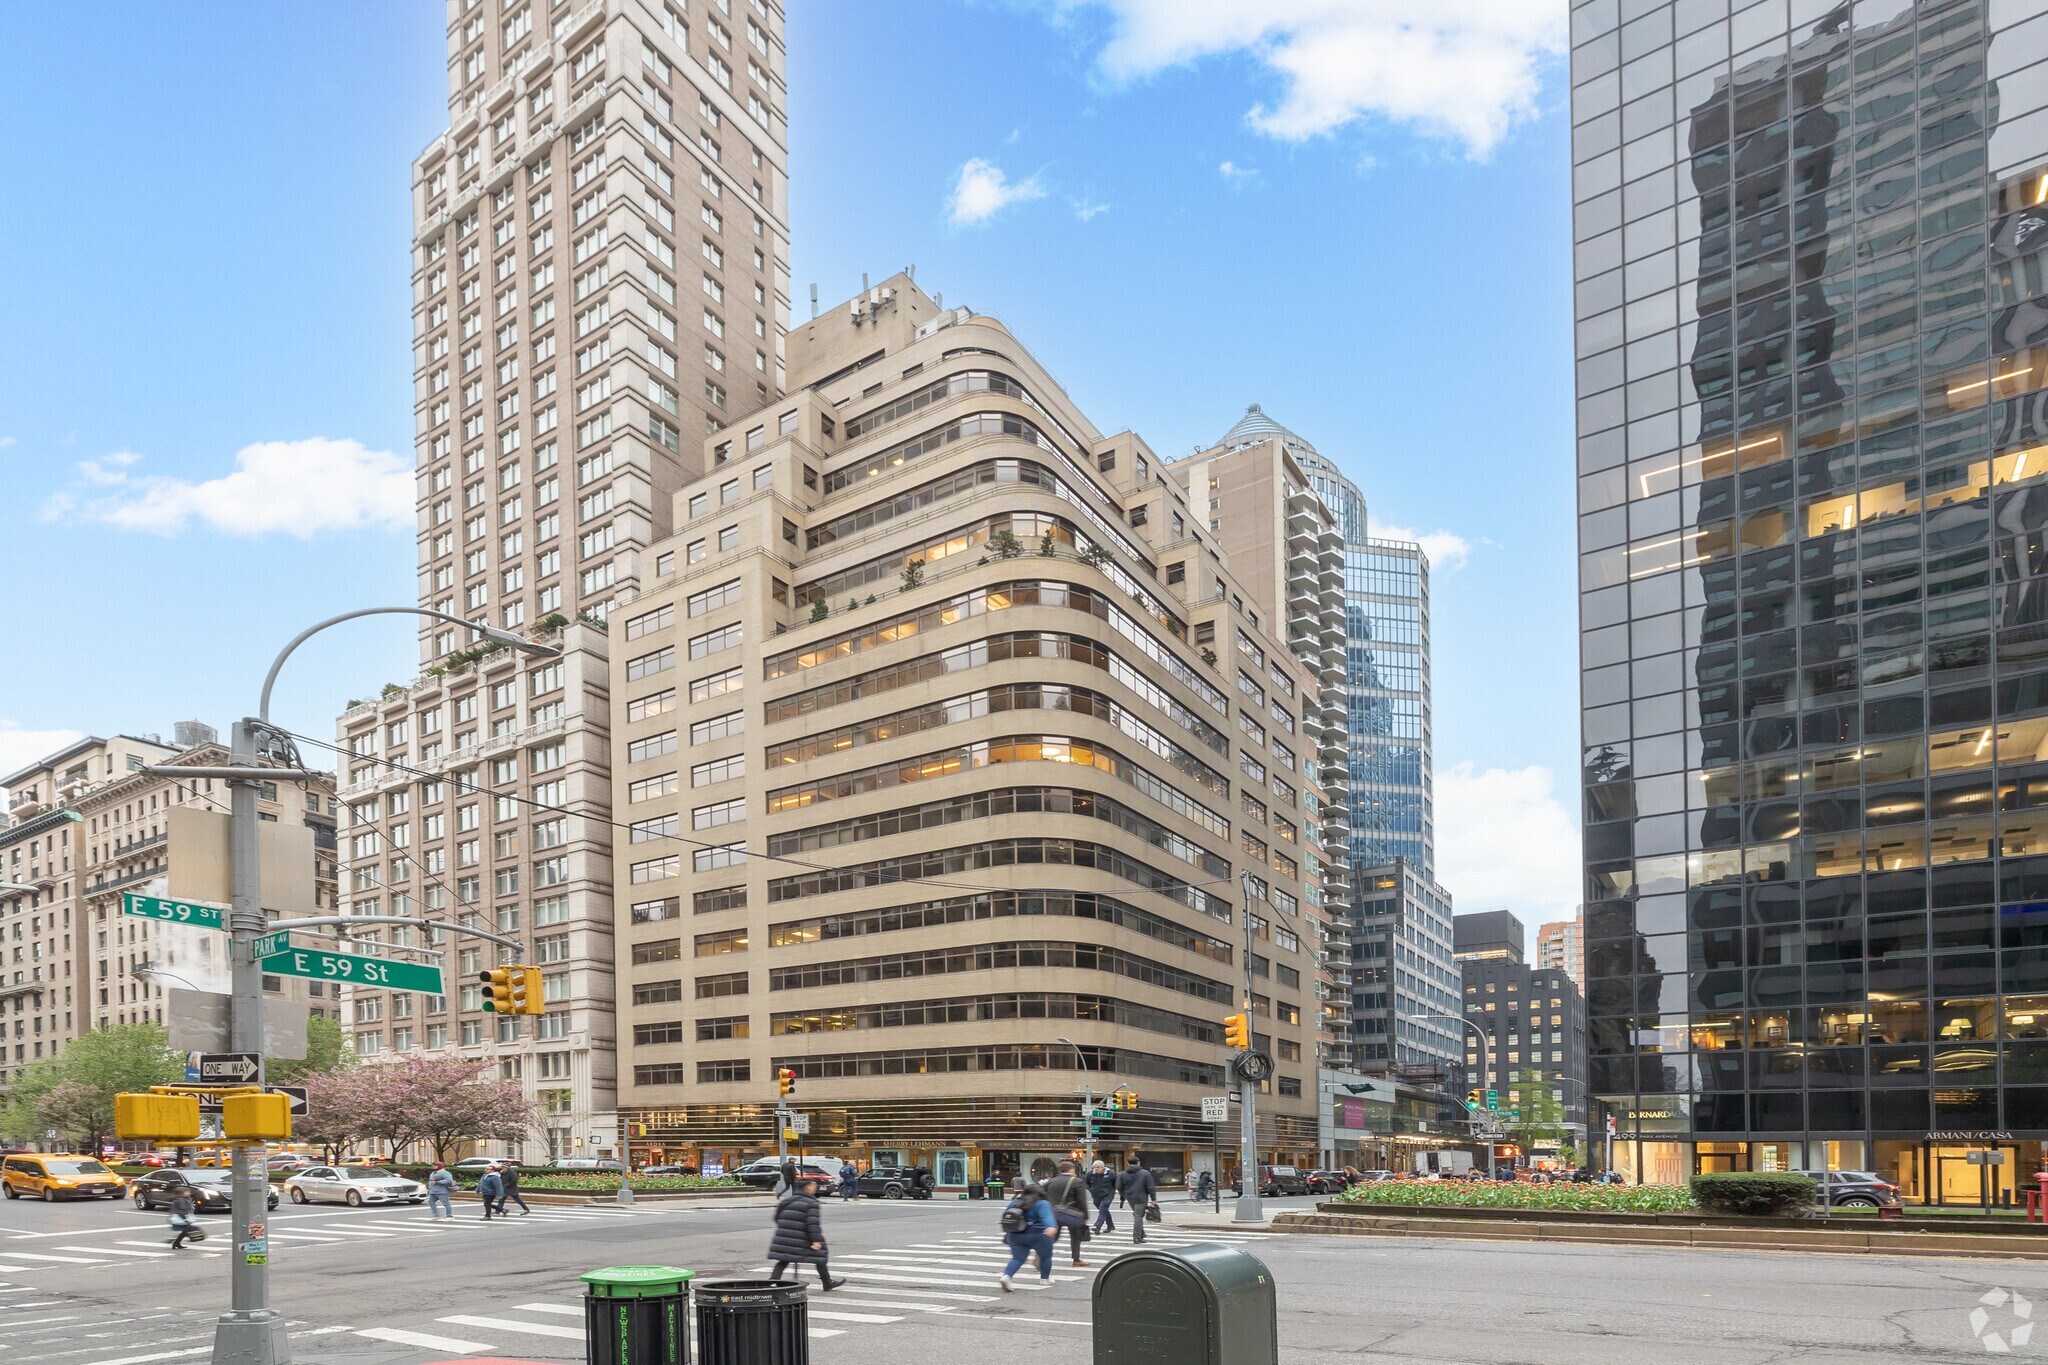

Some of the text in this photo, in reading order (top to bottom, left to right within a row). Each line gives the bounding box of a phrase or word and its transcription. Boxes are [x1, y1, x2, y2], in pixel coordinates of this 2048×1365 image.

[131, 896, 219, 921] E 59 ST
[254, 932, 288, 958] PARK AV
[294, 953, 389, 983] E 59 St
[204, 1062, 251, 1075] ONE WAY
[882, 1140, 947, 1148] SHERRY-LEHMANN
[667, 1304, 675, 1362] MAGAZINES
